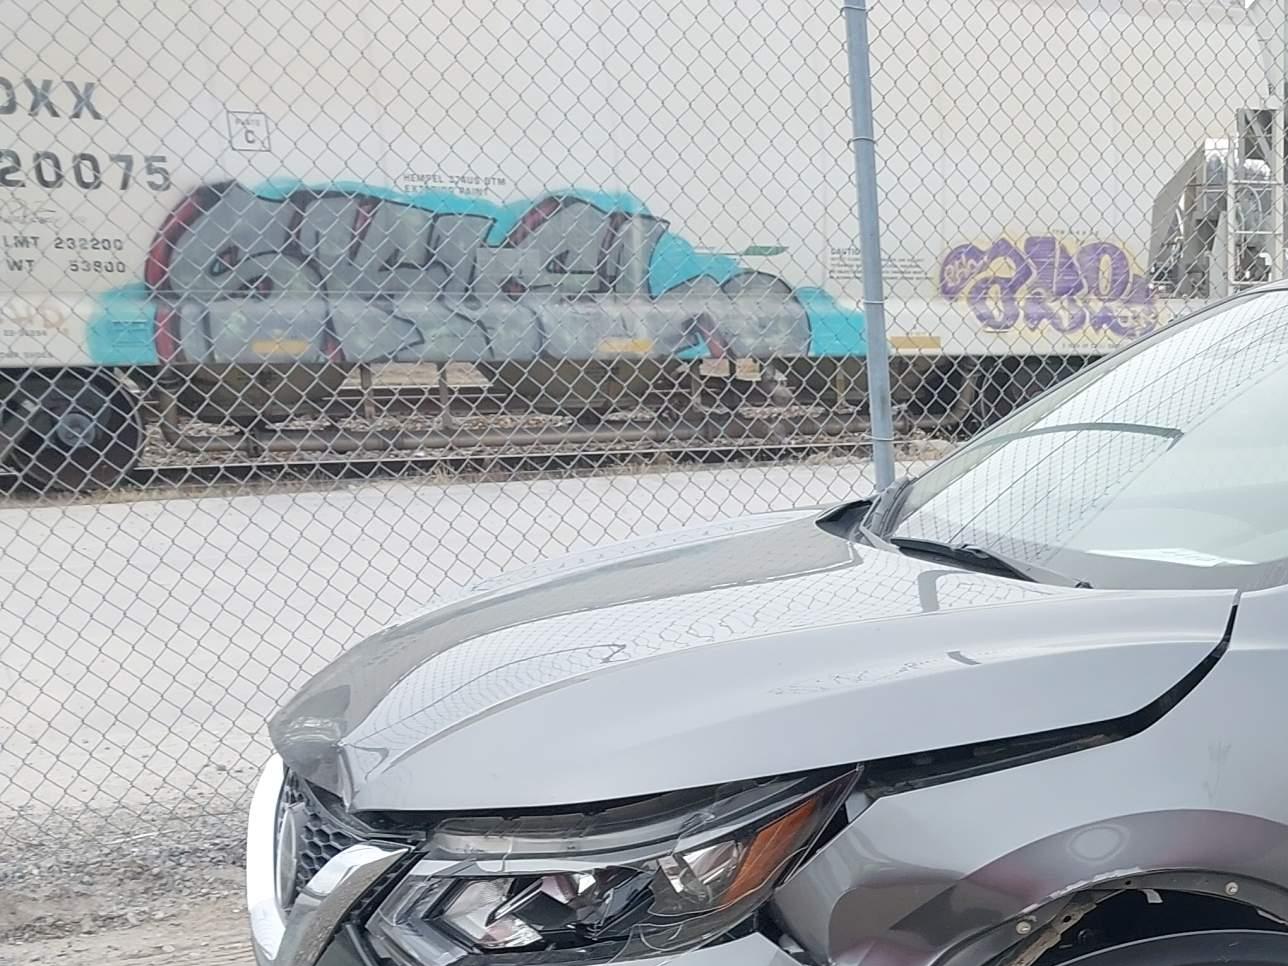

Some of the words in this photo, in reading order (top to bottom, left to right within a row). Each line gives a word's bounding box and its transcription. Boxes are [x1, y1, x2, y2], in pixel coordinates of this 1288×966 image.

[244, 129, 256, 144] C
[0, 149, 171, 191] 20075
[3, 236, 40, 249] LMT
[54, 237, 124, 251] 232200
[6, 260, 35, 272] WT
